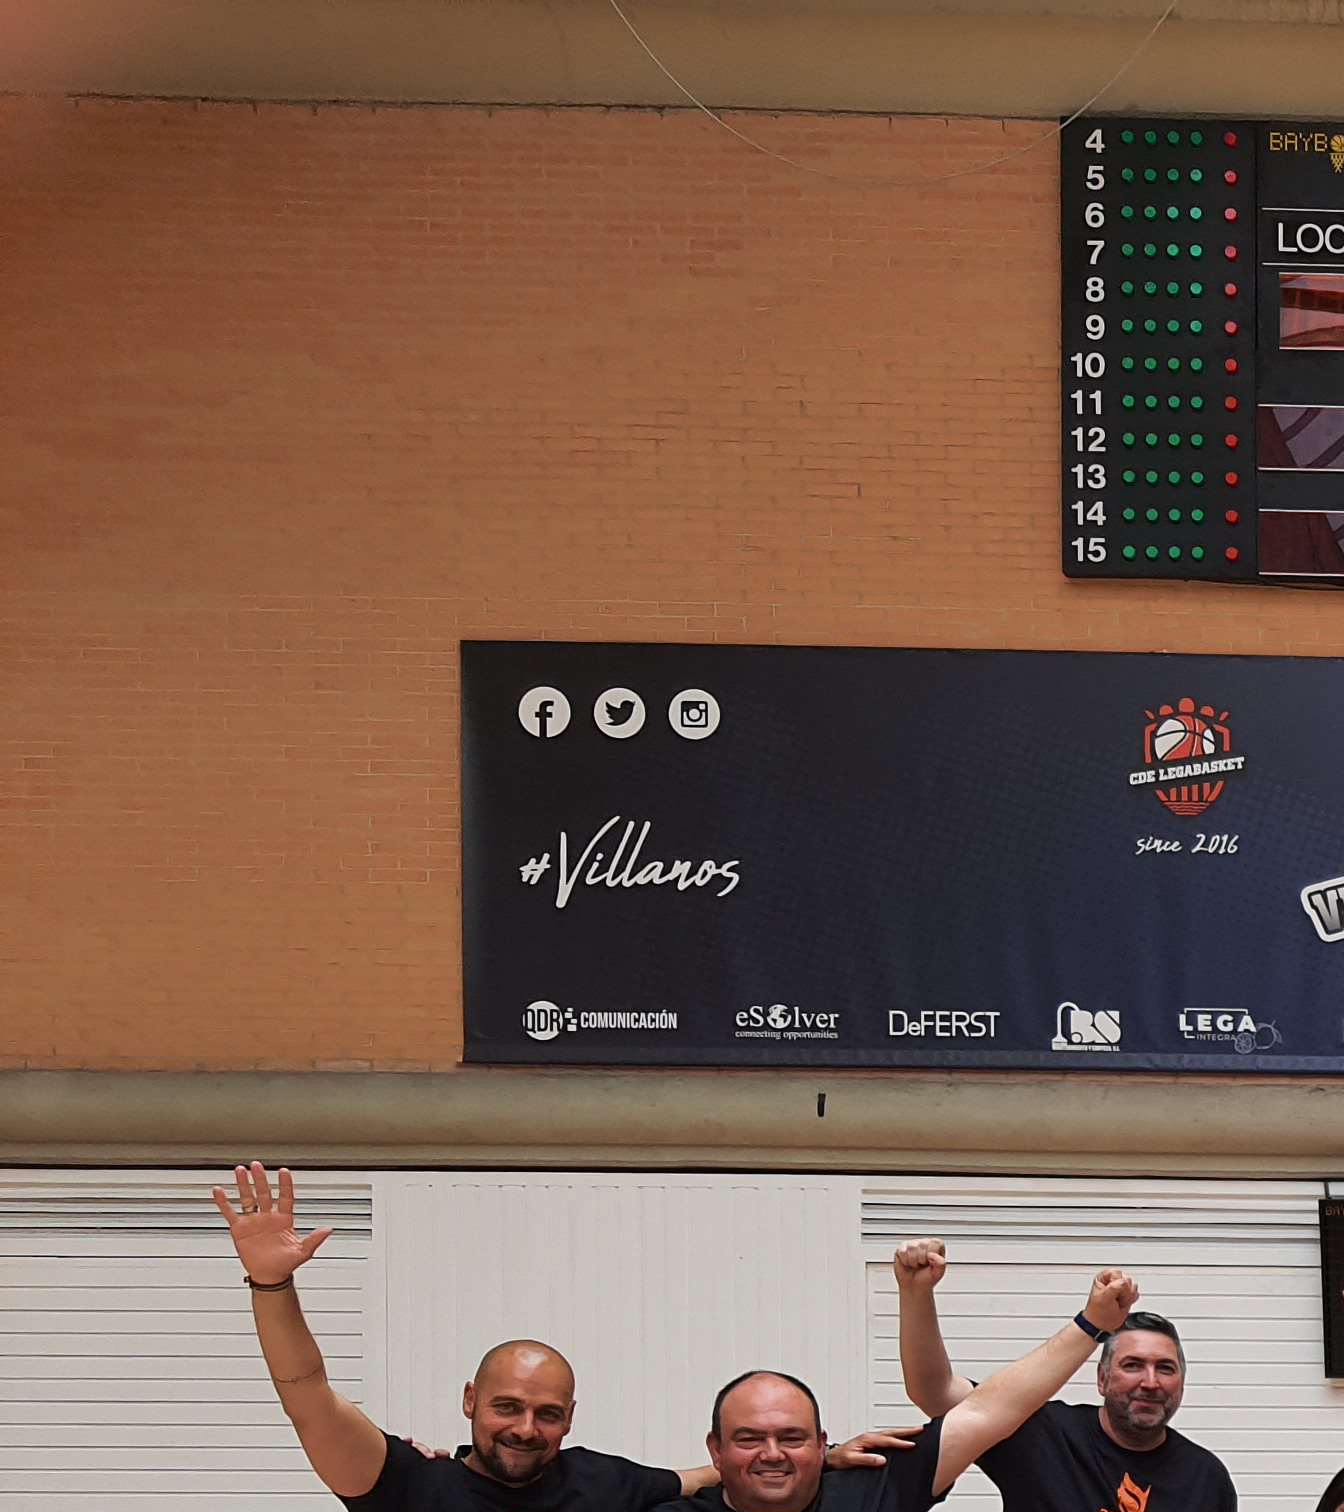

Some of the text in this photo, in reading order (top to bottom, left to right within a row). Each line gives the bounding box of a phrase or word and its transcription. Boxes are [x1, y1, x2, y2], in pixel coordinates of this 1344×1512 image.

[1086, 129, 1105, 153] 4
[1086, 166, 1104, 190] 5
[1085, 203, 1104, 227] 6
[1087, 241, 1104, 264] 7
[1086, 277, 1104, 302] 8
[1086, 315, 1104, 340] 9
[1071, 353, 1105, 377] 10
[1071, 390, 1101, 414] 11
[1071, 427, 1105, 451] 12
[1071, 464, 1106, 488] 13
[1072, 501, 1106, 525] 14
[1072, 538, 1106, 562] 15
[1129, 756, 1245, 786] CDE LEGABASKET
[1136, 833, 1239, 855] since 2016
[520, 816, 739, 908] #Villanos
[580, 1009, 678, 1029] COMUNICACIÓN
[889, 1011, 1000, 1037] DeFERST
[1179, 1014, 1257, 1032] LEGA
[735, 1029, 838, 1041] connecting opportunities
